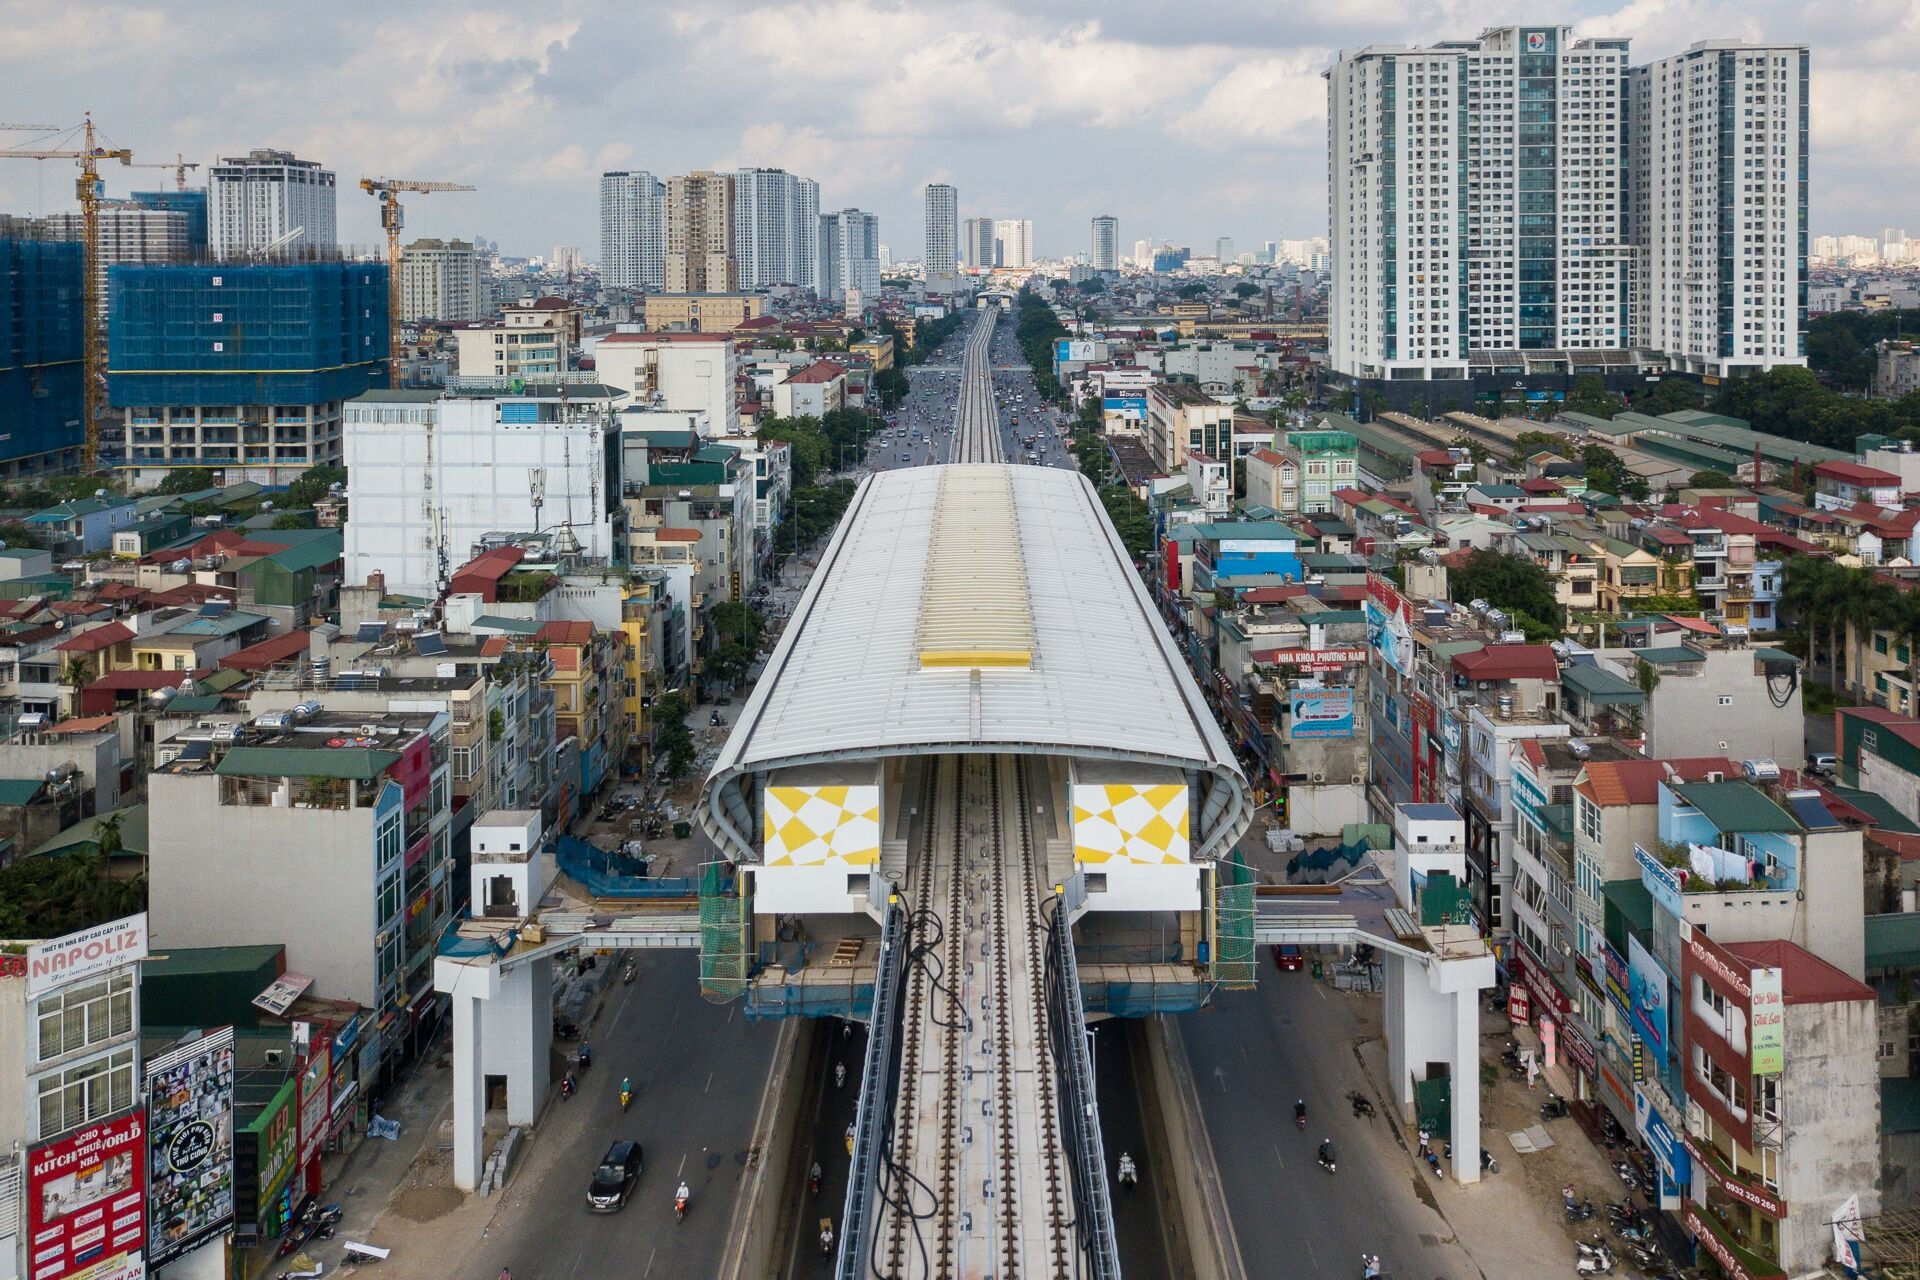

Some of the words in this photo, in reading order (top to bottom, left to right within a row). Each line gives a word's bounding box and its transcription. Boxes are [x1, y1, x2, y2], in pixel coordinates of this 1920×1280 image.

[1278, 653, 1294, 662] NHA
[1296, 653, 1315, 662] KHOA
[1317, 652, 1346, 662] PHƯƠNG
[1348, 651, 1366, 661] NAM
[42, 944, 56, 954] THIẾT
[90, 931, 101, 939] CAO
[114, 922, 129, 932] ITALY
[33, 930, 138, 978] NAPOLIZ
[1511, 985, 1527, 1001] KÍNH
[1512, 1001, 1526, 1018] MẮT
[80, 1129, 98, 1142] CHO
[268, 1105, 288, 1151] LED
[77, 1139, 101, 1156] THUÊ
[80, 1152, 100, 1168] NHÀ
[1726, 1182, 1744, 1197] 0932
[1745, 1191, 1760, 1204] 320
[1761, 1200, 1776, 1212] 266
